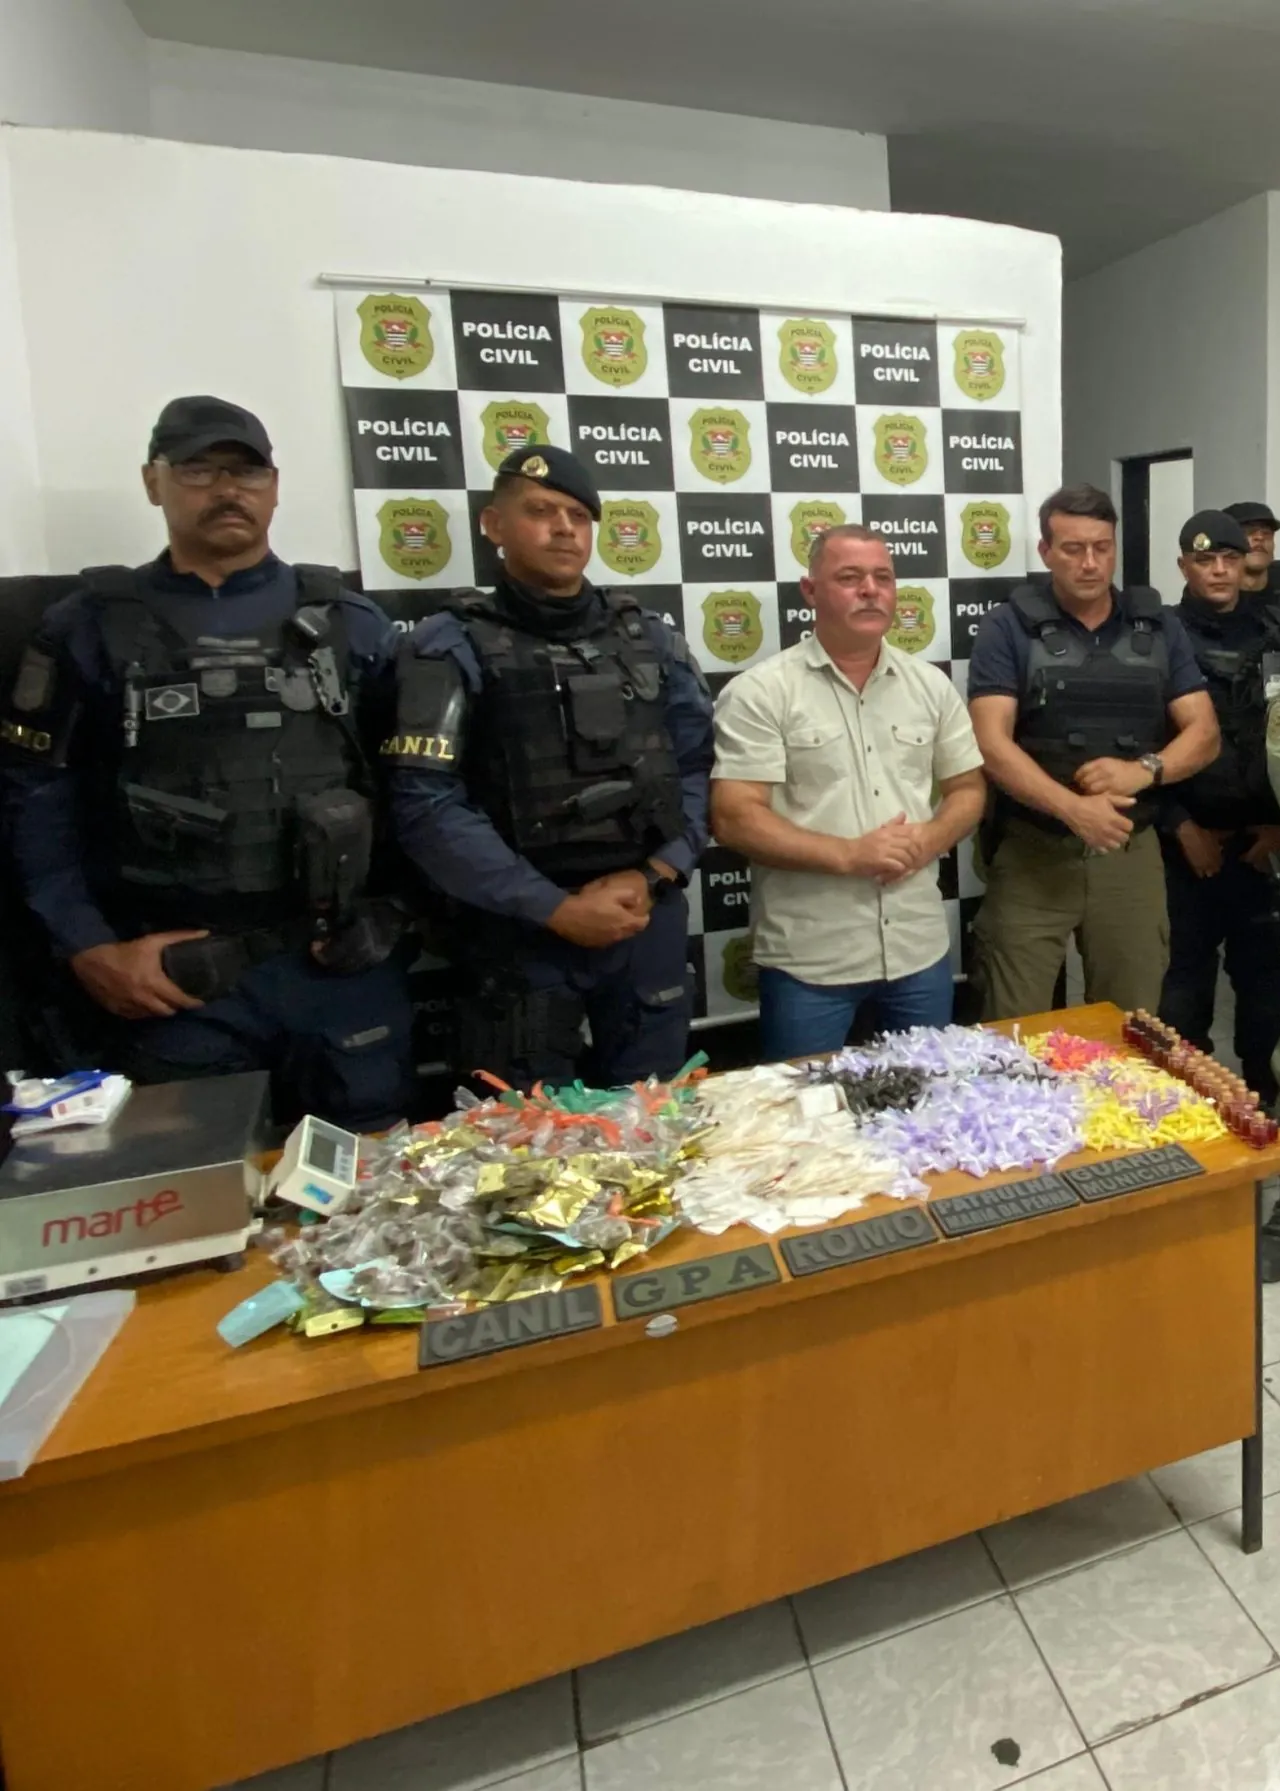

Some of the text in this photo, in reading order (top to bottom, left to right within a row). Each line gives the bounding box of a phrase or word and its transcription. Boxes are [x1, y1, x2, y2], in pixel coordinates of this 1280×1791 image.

[374, 304, 415, 316] POLÍCIA
[594, 316, 632, 327] POLÍCIA
[462, 321, 552, 341] POLÍCIA
[790, 328, 824, 339] POLÍCIA
[673, 333, 753, 351] POLÍCIA
[382, 355, 415, 365] CIVIL
[480, 348, 539, 365] CIVIL
[860, 343, 931, 361] POLÍCIA
[601, 364, 631, 375] CIVIL
[688, 358, 741, 374] CIVIL
[873, 367, 920, 383] CIVIL
[495, 410, 534, 421] POLÍCIA
[702, 416, 736, 427] POLÍCIA
[357, 418, 452, 437] POLÍCIA
[578, 424, 663, 442] POLÍCIA
[776, 429, 849, 447] POLÍCIA
[949, 433, 1015, 450] POLÍCIA
[376, 446, 438, 461] CIVIL
[595, 450, 650, 465] CIVIL
[790, 454, 838, 469] CIVIL
[961, 457, 1005, 471] CIVIL
[392, 507, 434, 518] POLÍCIA
[608, 508, 646, 519] POLÍCIA
[801, 507, 834, 518] POLÍCIA
[686, 518, 765, 535] POLÍCIA
[869, 518, 938, 534] POLÍCIA
[701, 543, 753, 558] CIVIL
[886, 542, 928, 555] CIVIL
[1071, 1144, 1185, 1182] GUARDA
[1080, 1159, 1199, 1195] MUNICIPAL
[935, 1174, 1061, 1215] PATRULHA
[42, 1189, 186, 1248] marte
[788, 1212, 926, 1268] ROMO
[623, 1254, 772, 1308] GPA
[430, 1296, 596, 1360] CANIL
